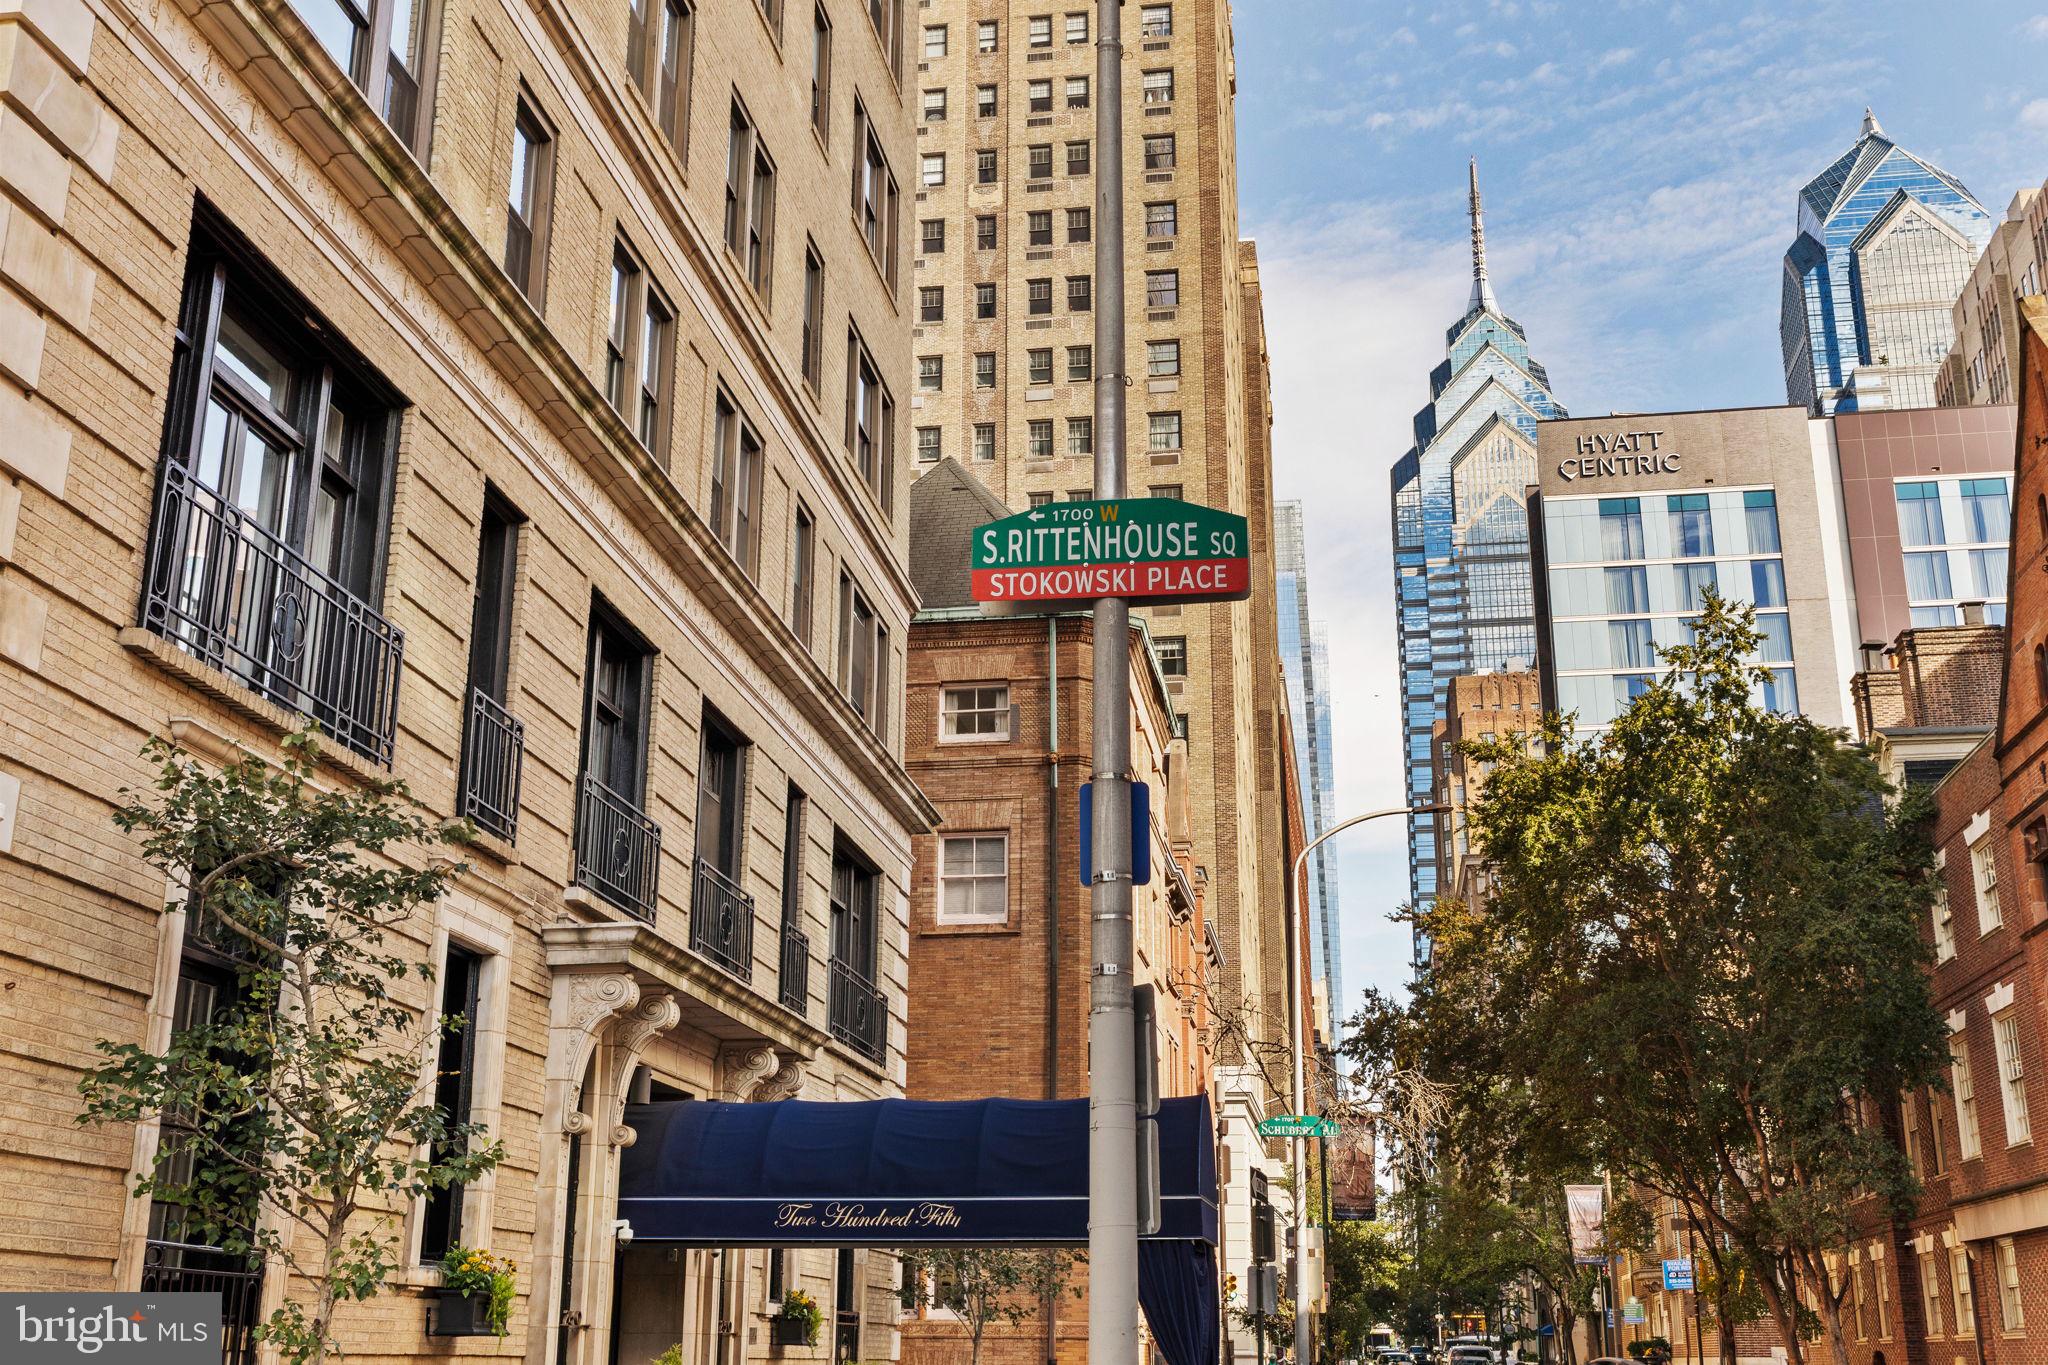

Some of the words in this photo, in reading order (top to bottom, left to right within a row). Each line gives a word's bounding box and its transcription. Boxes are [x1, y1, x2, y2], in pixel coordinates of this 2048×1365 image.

[1578, 430, 1664, 453] HYATT
[1560, 453, 1682, 481] CENTRIC
[1052, 508, 1094, 522] 1700
[1100, 504, 1119, 522] W
[1210, 531, 1236, 557] SQ
[990, 568, 1136, 597] STOKOWSKI
[1148, 564, 1228, 590] PLACE
[774, 1202, 817, 1228] Two
[821, 1201, 915, 1228] Hundred
[915, 1201, 962, 1228] Fifty
